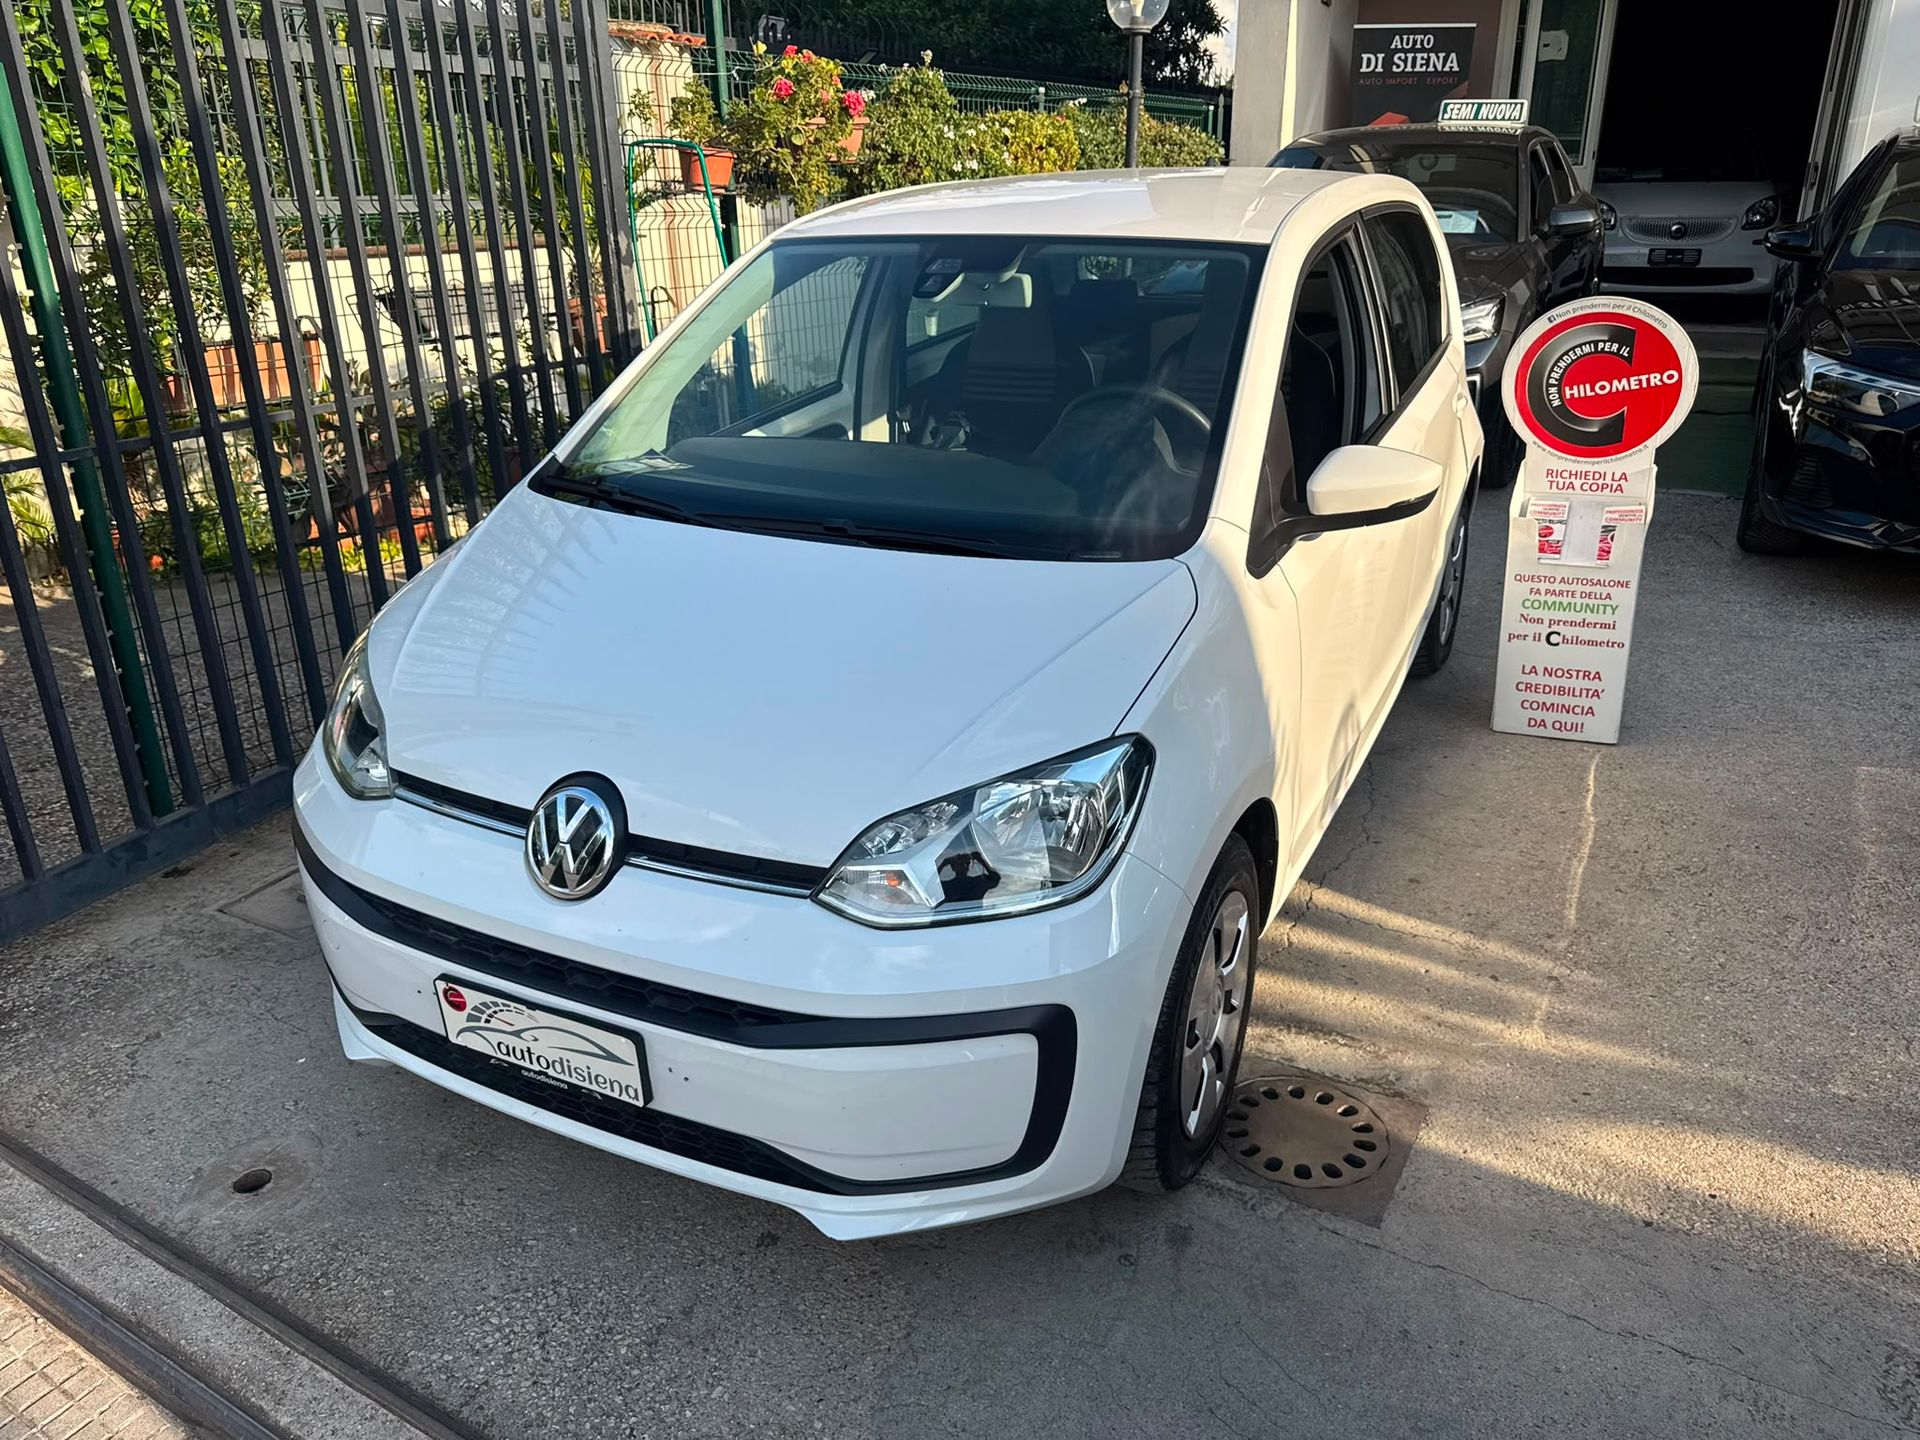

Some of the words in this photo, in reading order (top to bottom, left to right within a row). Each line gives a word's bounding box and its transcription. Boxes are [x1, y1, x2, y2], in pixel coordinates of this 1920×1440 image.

[1390, 34, 1434, 50] AUTO
[1359, 53, 1384, 73] DI
[1392, 52, 1460, 73] SIENA
[1358, 77, 1383, 86] AUTO
[1385, 77, 1418, 86] IMPORT
[1426, 76, 1459, 86] EXPORT
[1443, 103, 1478, 120] SEMI
[1478, 103, 1522, 120] NUOVA
[1556, 309, 1571, 319] Non
[1572, 302, 1611, 314] prendermi
[1612, 303, 1625, 311] per
[1632, 306, 1668, 330] Chilometro
[1598, 342, 1618, 353] PER
[1620, 345, 1631, 357] IL
[1549, 343, 1595, 385] PRENDERMI
[1549, 387, 1562, 407] NON
[1545, 468, 1607, 482] RICHIEDI
[1611, 471, 1629, 483] LA
[1547, 480, 1576, 492] TUA
[1580, 482, 1625, 494] COPIA
[1514, 573, 1557, 585] QUESTO
[1559, 577, 1632, 589] AUTOSALONE
[1529, 587, 1542, 596] FA
[1544, 588, 1577, 598] PARTE
[1580, 591, 1613, 601] DELLA
[1521, 598, 1619, 616] COMMUNITY
[1519, 613, 1544, 625] Non
[1548, 617, 1617, 631] prendermi
[1508, 632, 1529, 643] per
[1533, 632, 1542, 643] il
[1545, 631, 1626, 649] Chilometro
[1521, 664, 1539, 676] LA
[1543, 666, 1603, 682] NOSTRA
[1515, 681, 1606, 700] CREDIBILITA'
[1520, 699, 1596, 717] COMINCIA
[1527, 717, 1548, 730] DA
[1552, 720, 1585, 733] QUI!
[497, 1040, 640, 1102] autodisiena
[521, 1069, 569, 1090] autodisiena
